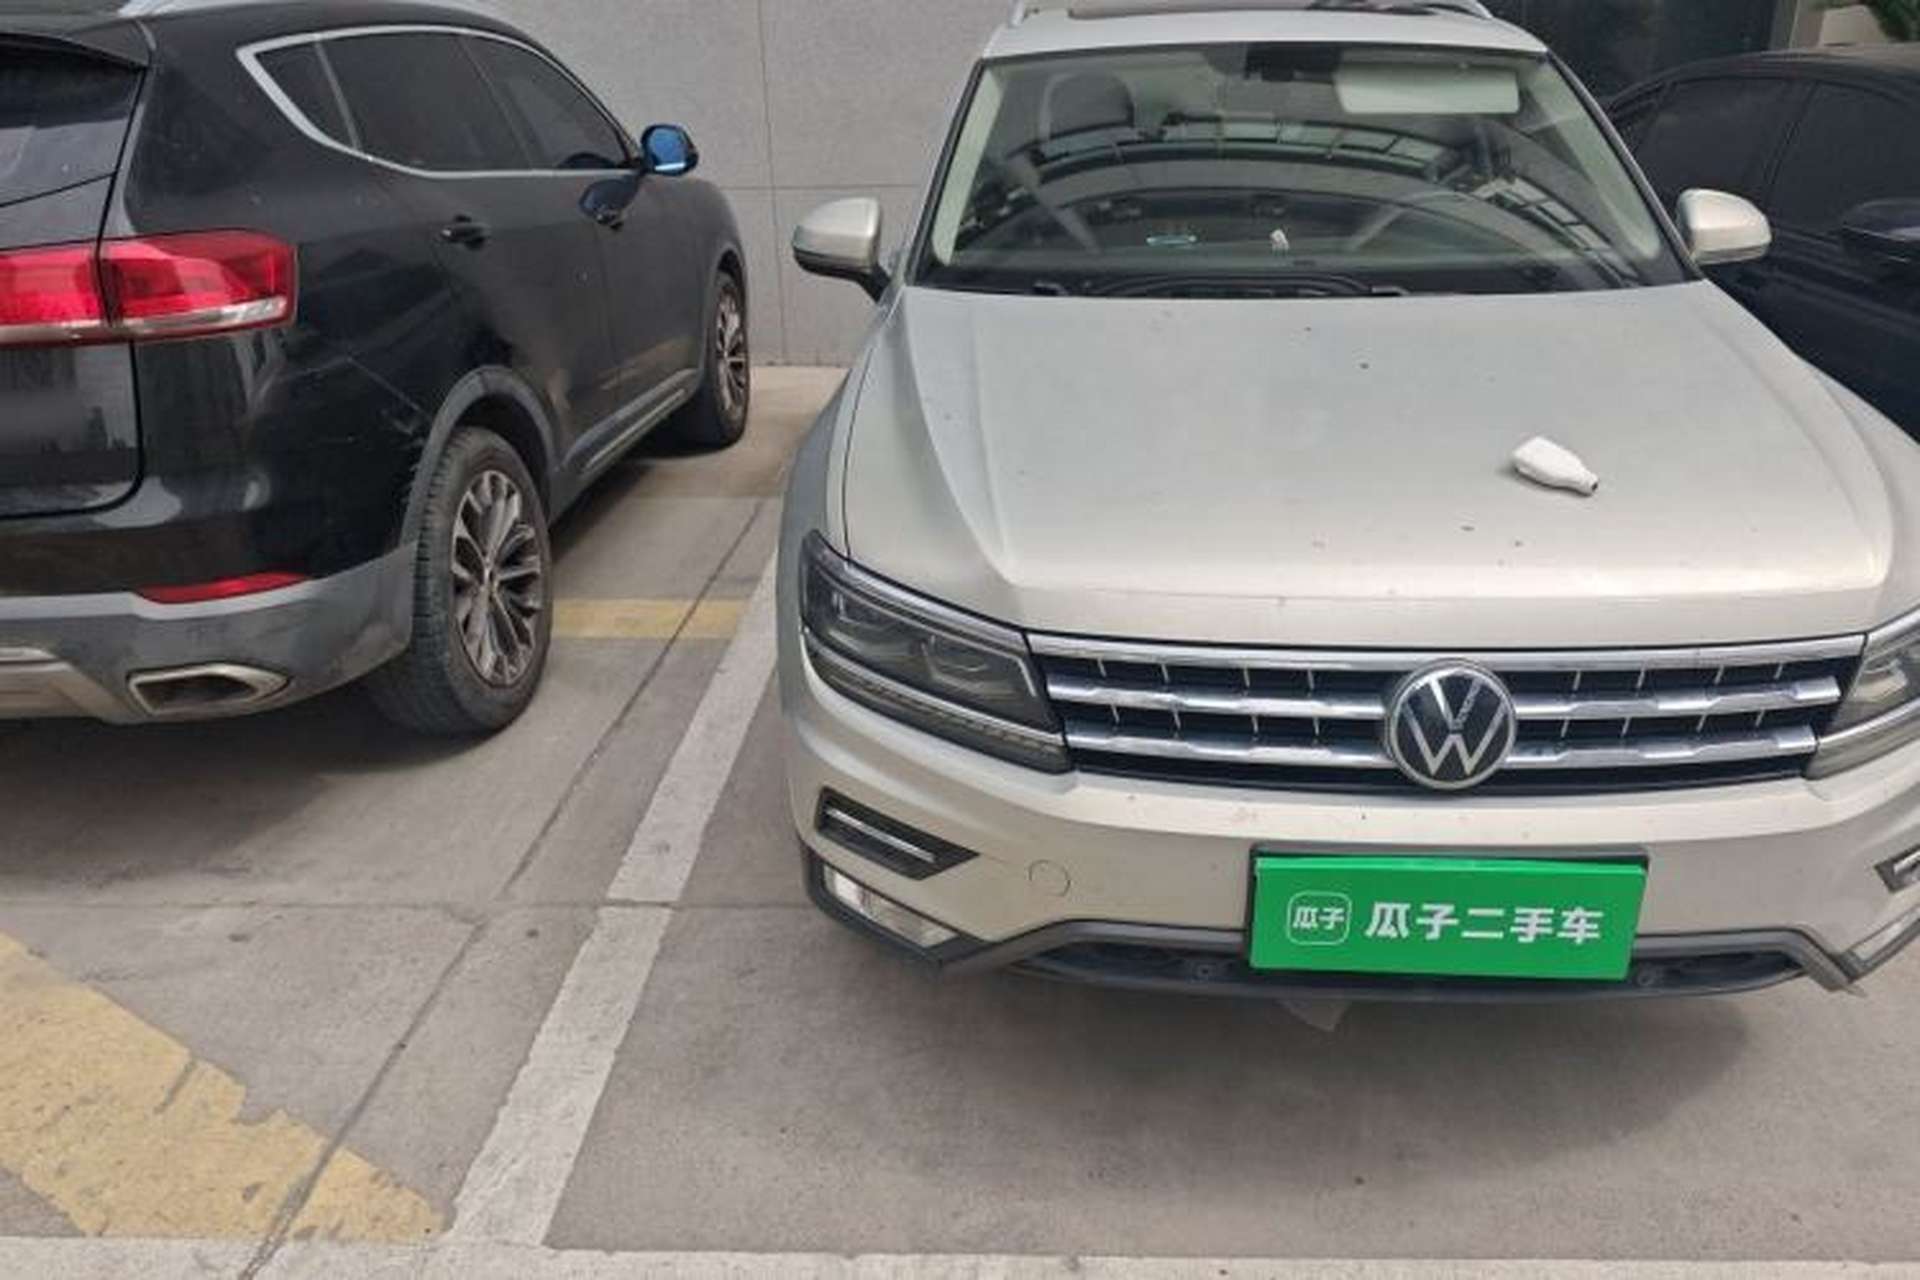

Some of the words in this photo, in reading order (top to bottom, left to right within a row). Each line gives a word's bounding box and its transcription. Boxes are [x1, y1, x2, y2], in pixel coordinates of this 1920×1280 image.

[1293, 905, 1345, 931] 瓜子
[1364, 901, 1604, 944] 瓜子二手车
